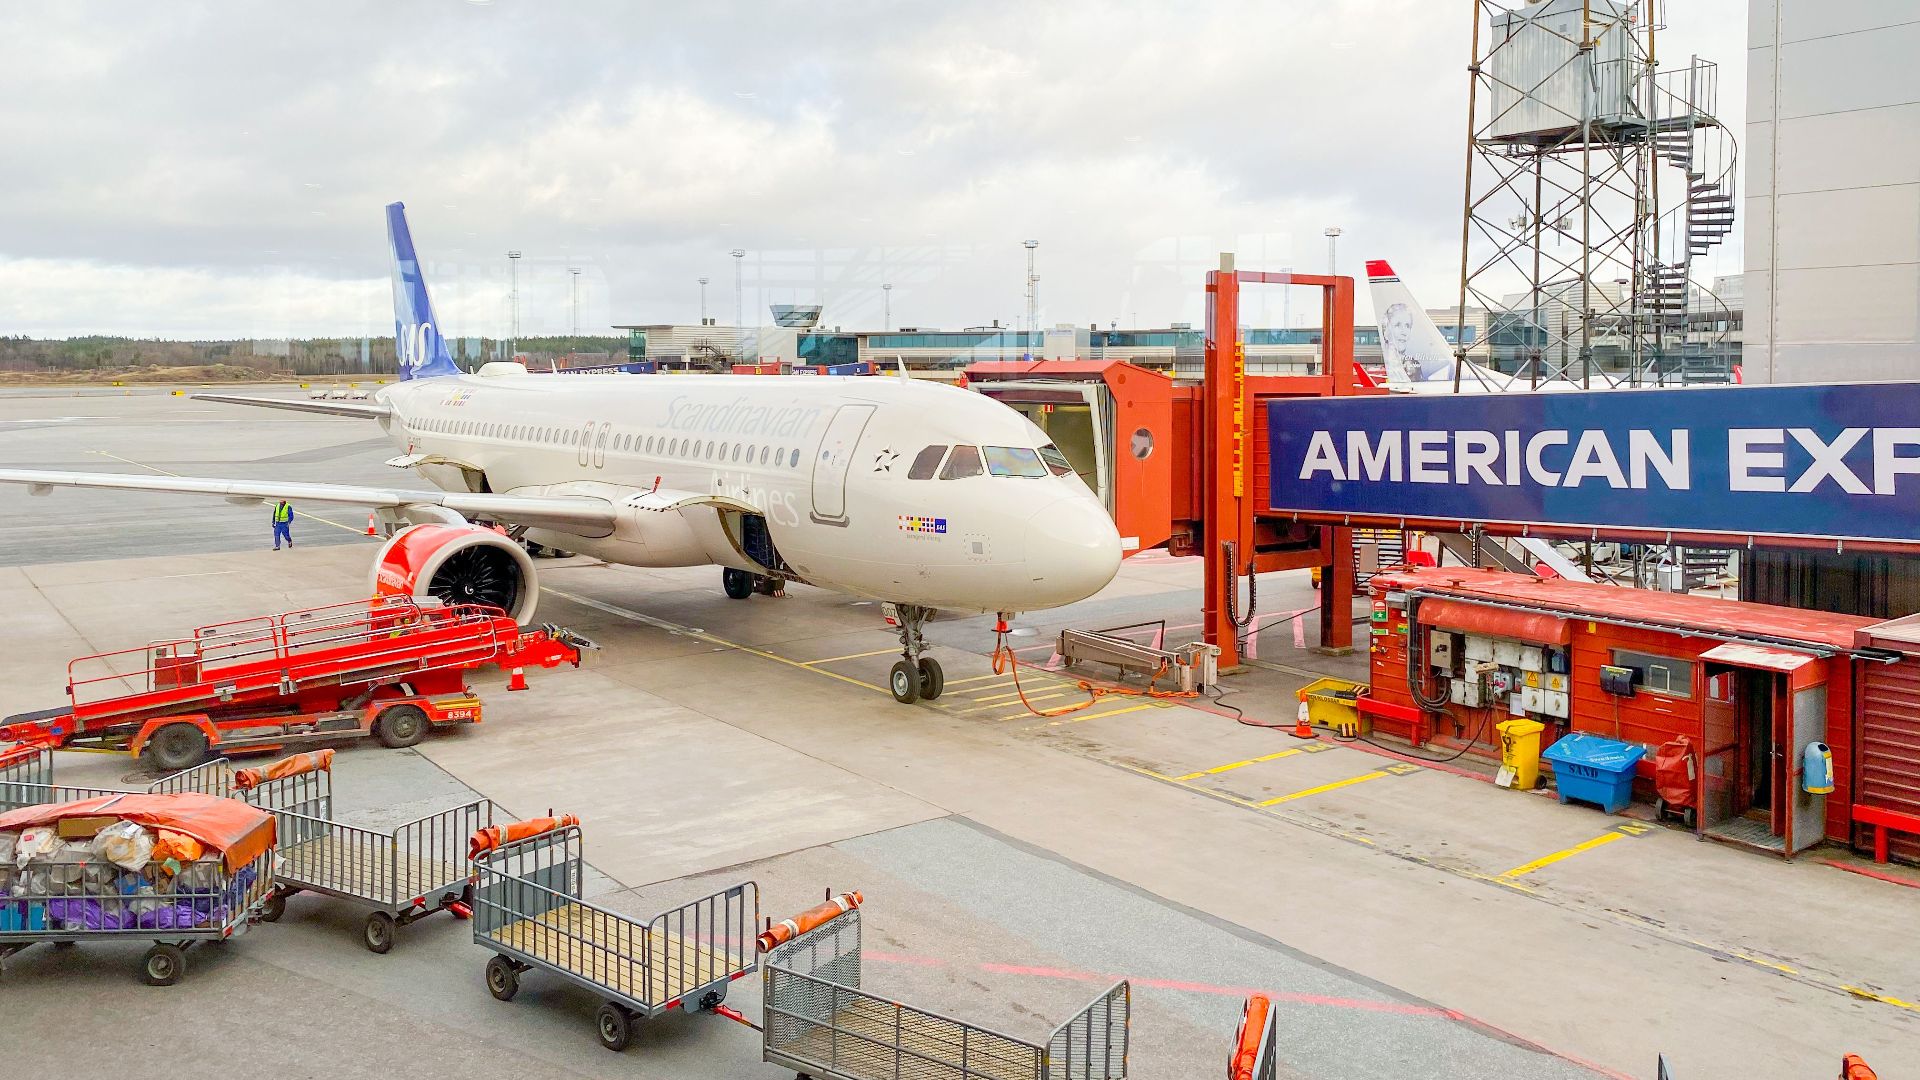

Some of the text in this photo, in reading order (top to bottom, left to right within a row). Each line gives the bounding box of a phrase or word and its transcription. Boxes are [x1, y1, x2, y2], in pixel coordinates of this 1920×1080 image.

[656, 394, 821, 439] Scandinavian
[1299, 430, 1690, 490] AMERICAN
[1568, 763, 1600, 779] SAND
